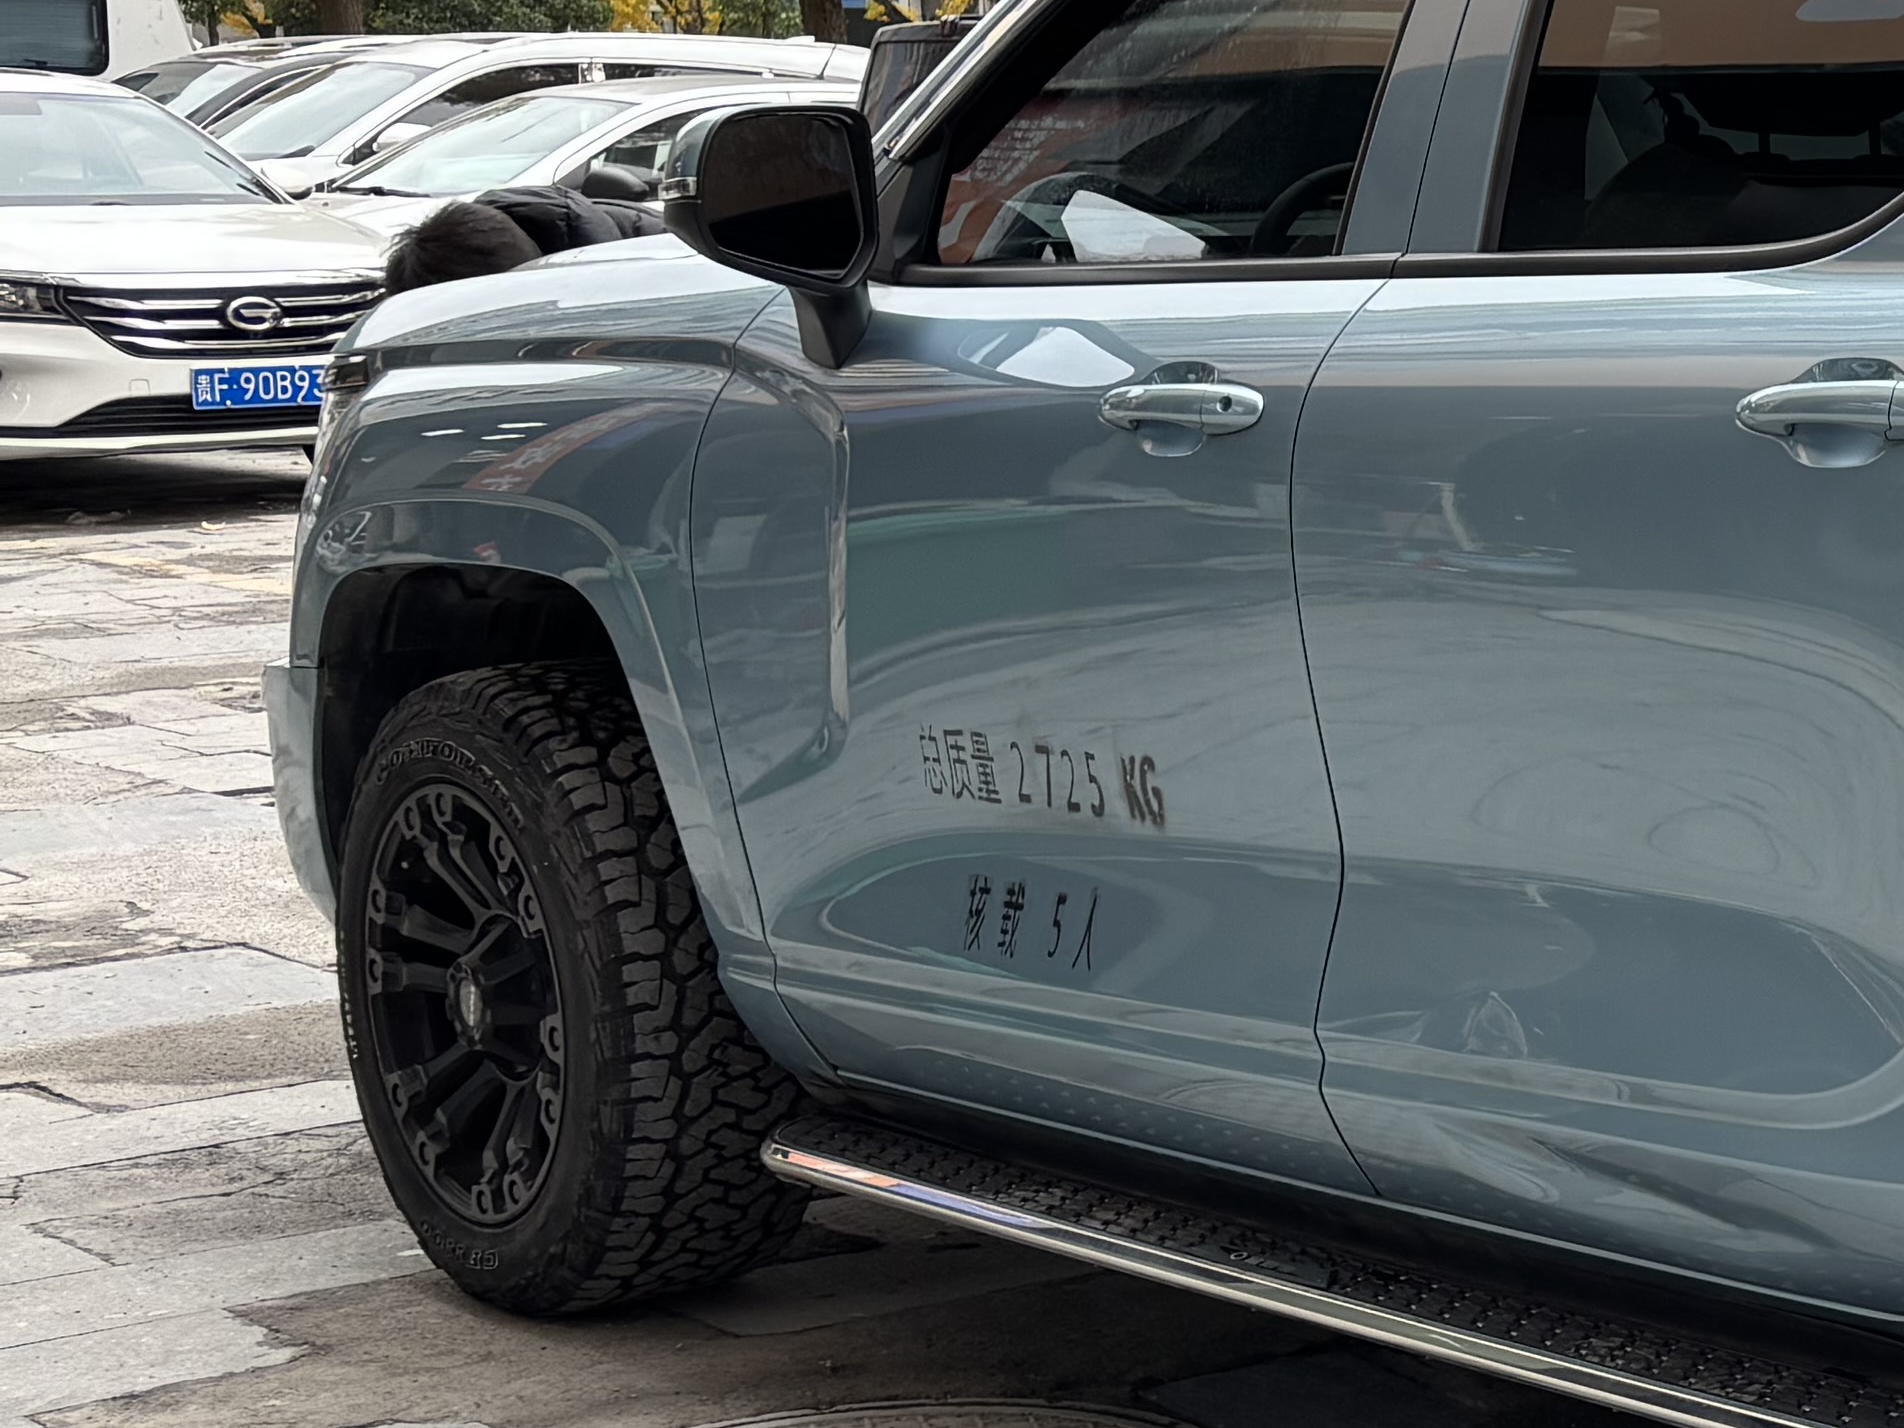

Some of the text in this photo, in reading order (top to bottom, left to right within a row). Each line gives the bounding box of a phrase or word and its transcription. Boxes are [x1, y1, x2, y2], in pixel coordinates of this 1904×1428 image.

[919, 724, 1002, 804] 总质量
[1119, 753, 1166, 829] KG
